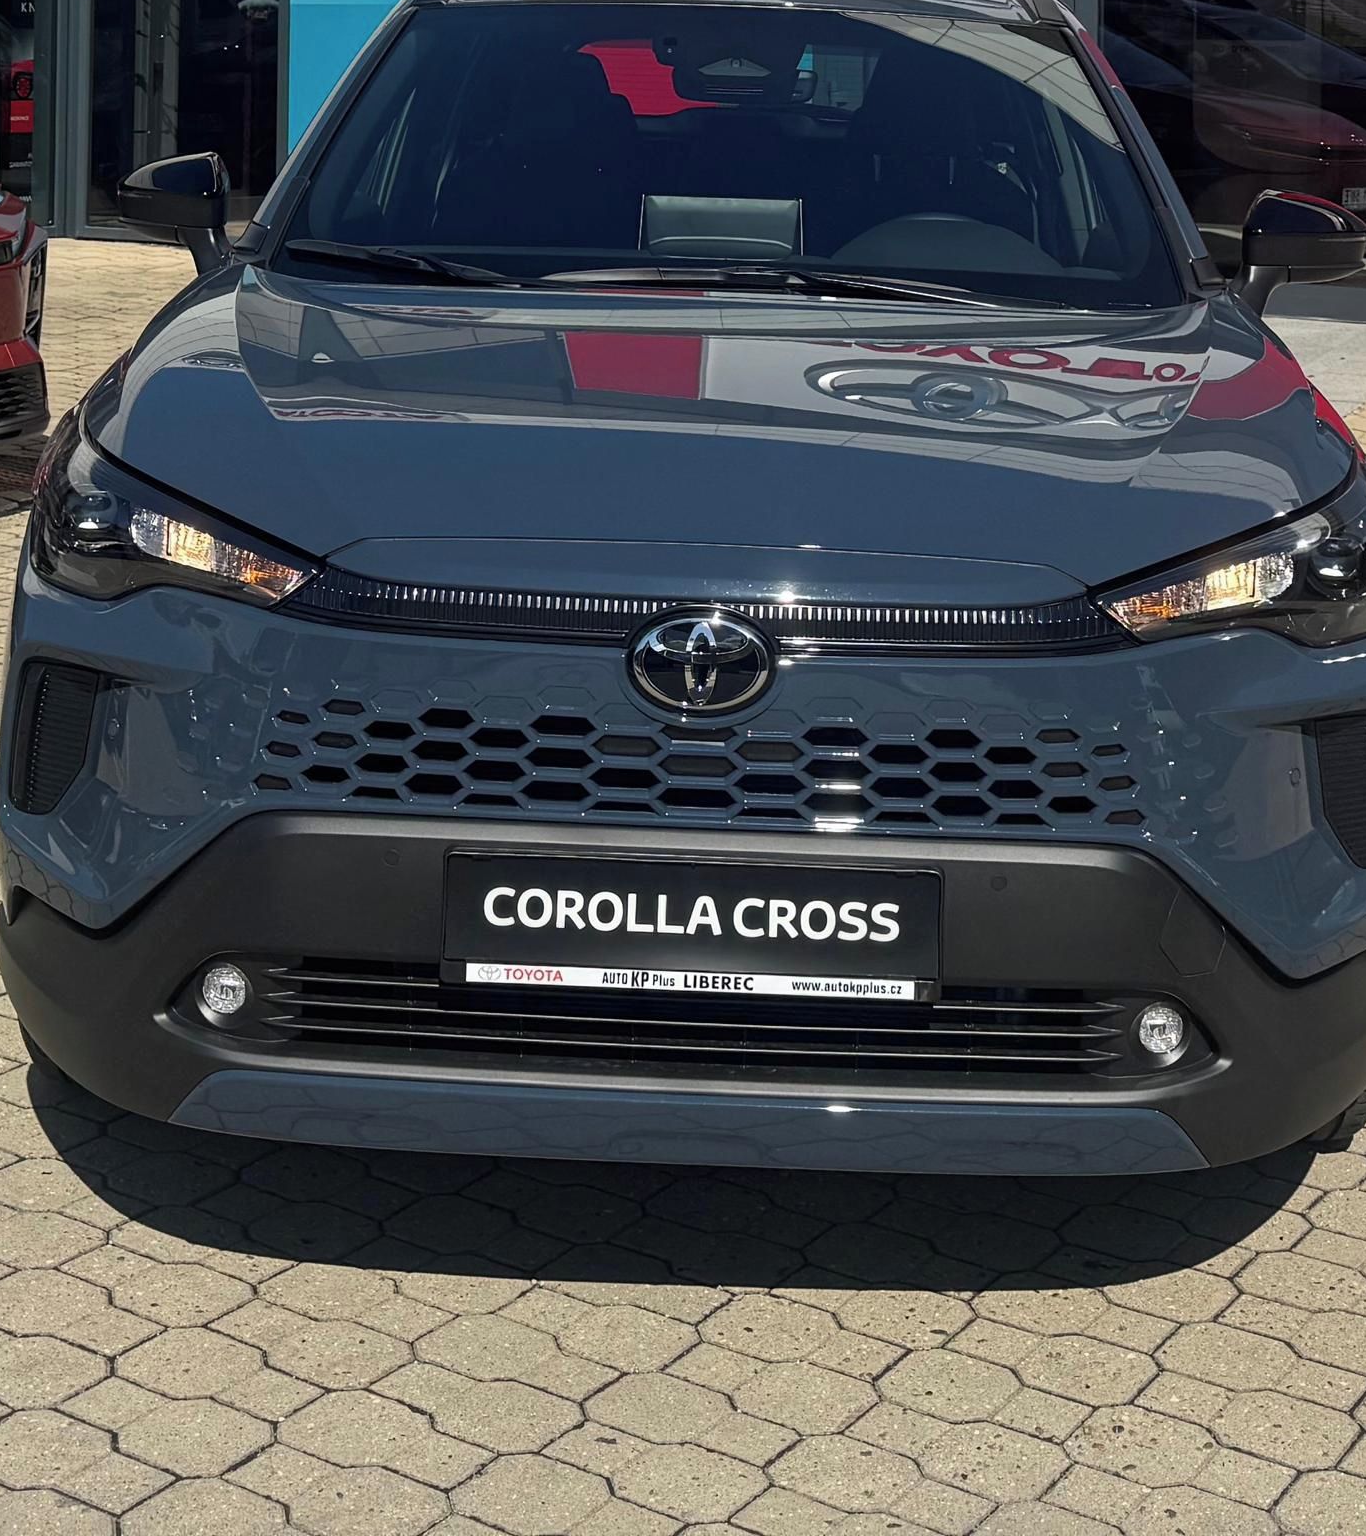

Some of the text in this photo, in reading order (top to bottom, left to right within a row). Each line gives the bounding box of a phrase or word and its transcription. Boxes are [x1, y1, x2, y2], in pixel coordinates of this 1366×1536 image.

[482, 886, 901, 943] COROLLA CROSS
[503, 968, 902, 996] TOYOTA AUTO KP Plus LIBEREC www.autokpplus.cz
